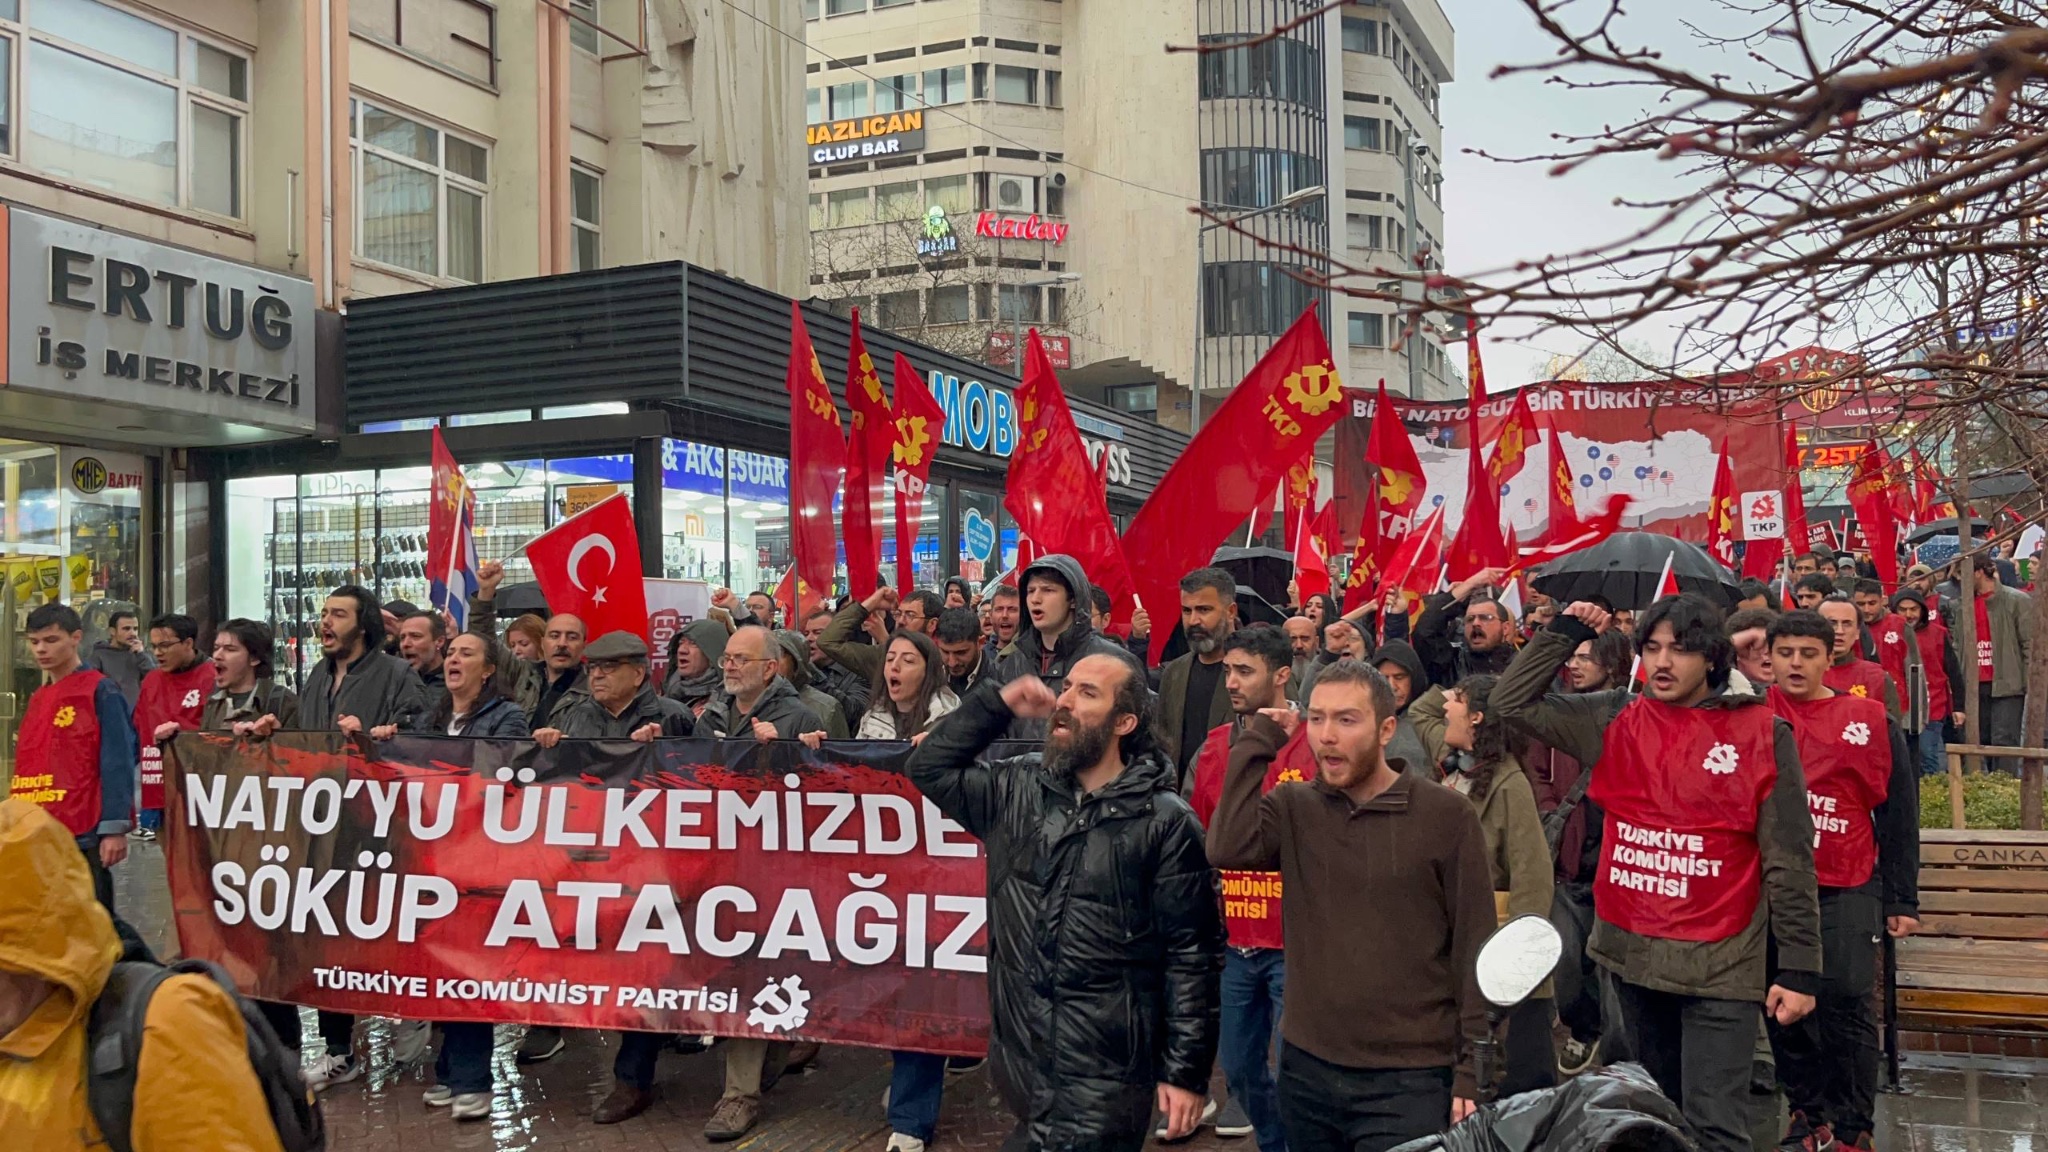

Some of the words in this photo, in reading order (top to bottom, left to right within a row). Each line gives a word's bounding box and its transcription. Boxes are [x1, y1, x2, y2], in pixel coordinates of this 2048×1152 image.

[813, 144, 859, 163] CLUP
[862, 139, 899, 156] BAR
[975, 211, 1069, 245] Kızılay
[48, 246, 293, 350] ERTUĞ
[37, 326, 86, 379] İŞ
[103, 348, 299, 406] MERKEZİ
[928, 370, 1019, 457] MOB
[1262, 394, 1301, 436] TKP
[1526, 390, 1565, 412] BİR
[1569, 386, 1674, 410] TÜRKİYE
[685, 443, 787, 488] AKSESUAR
[893, 465, 924, 498] KP
[1379, 510, 1412, 540] KP
[1750, 523, 1777, 532] TKP
[186, 774, 459, 839] NATO'YU
[482, 766, 982, 858] ÜLKEMİZDE
[1612, 844, 1722, 877] KOMÜNİST
[1222, 877, 1283, 898] OMÜNİS
[1609, 867, 1688, 898] PARTİSİ
[212, 844, 459, 943] SÖKÜP
[484, 872, 987, 973] ATACAĞIZ
[1225, 898, 1267, 919] RTİSİ
[313, 967, 427, 998] TÜRKİYE
[435, 976, 609, 1007] KOMÜNİST
[616, 985, 738, 1013] PARTİSİ
